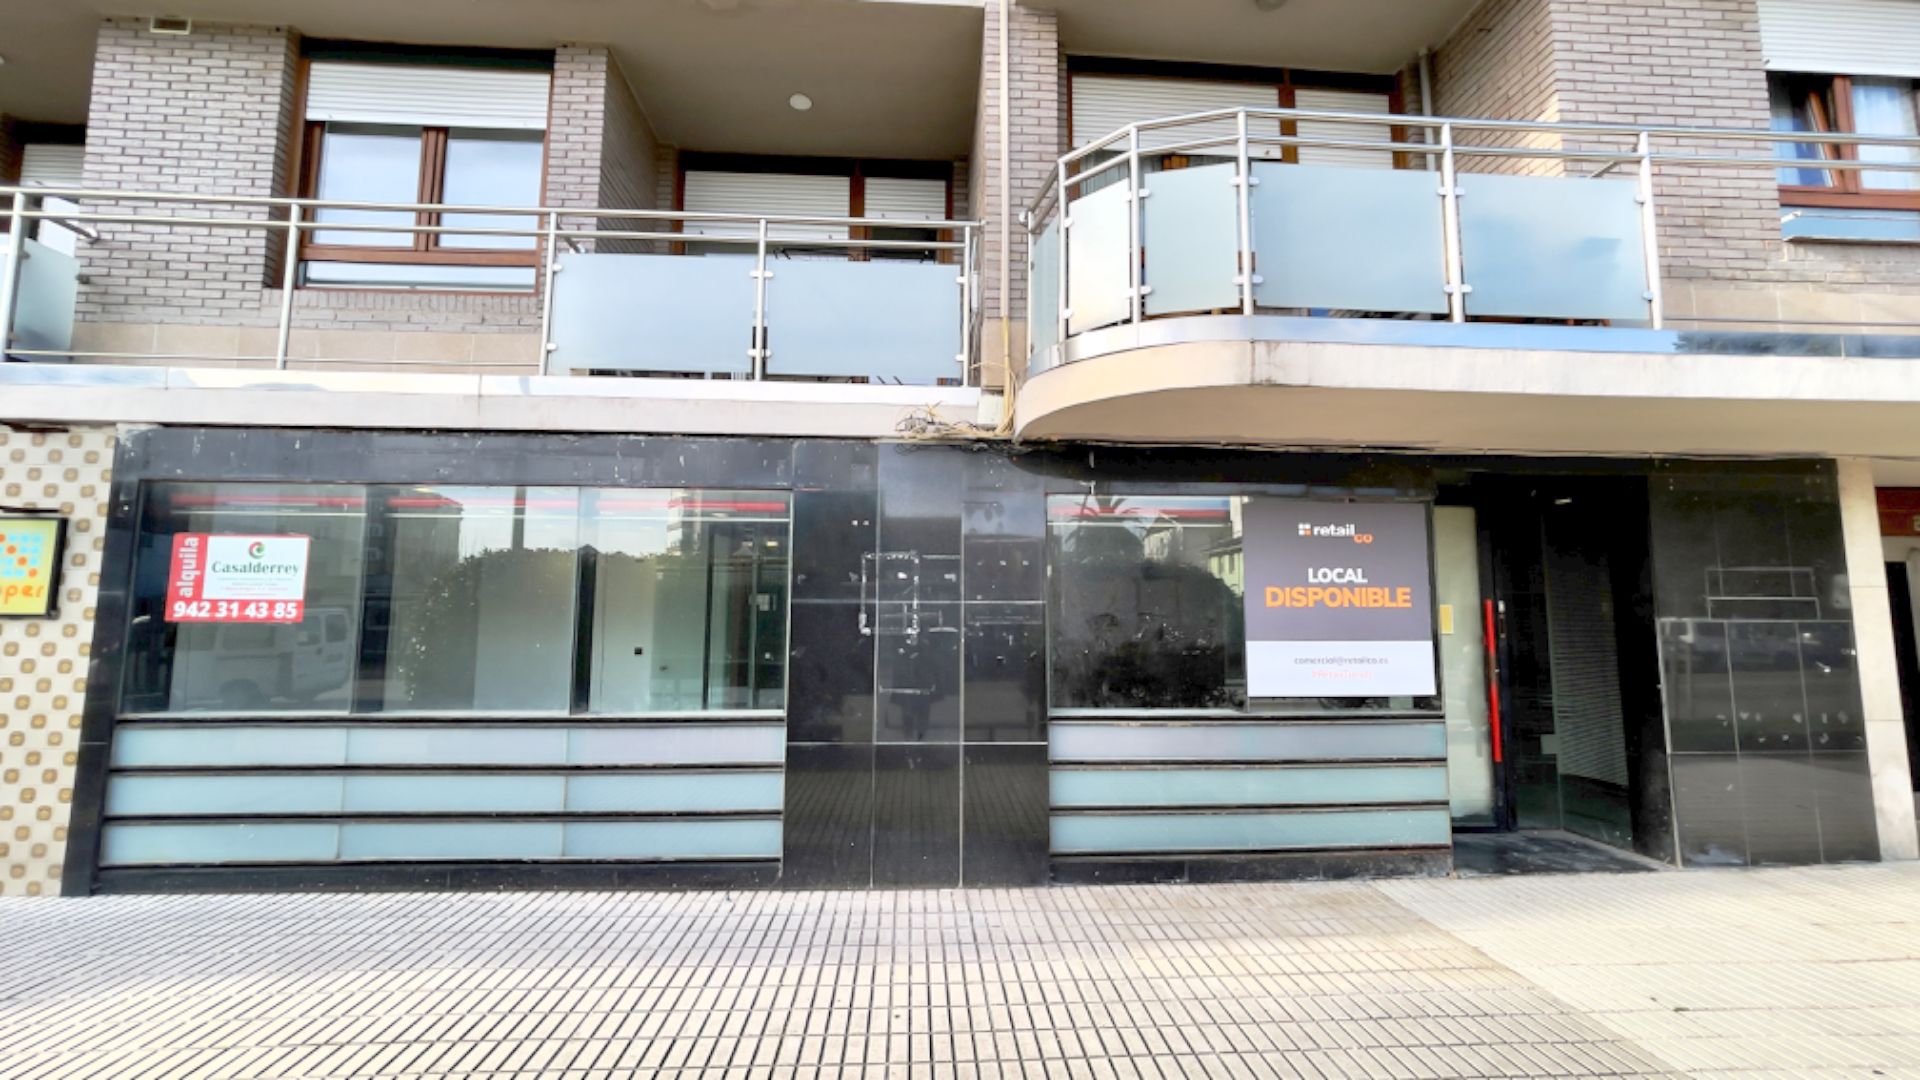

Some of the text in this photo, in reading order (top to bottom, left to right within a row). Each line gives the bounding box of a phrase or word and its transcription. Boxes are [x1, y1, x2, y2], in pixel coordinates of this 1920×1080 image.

[1313, 523, 1374, 544] retail co
[176, 537, 201, 598] alquila
[211, 561, 299, 577] Casalderrey
[1307, 567, 1368, 583] LOCAL
[0, 585, 44, 605] per
[1264, 586, 1412, 608] DISPONIBLE
[173, 601, 298, 619] 942 31 43 85
